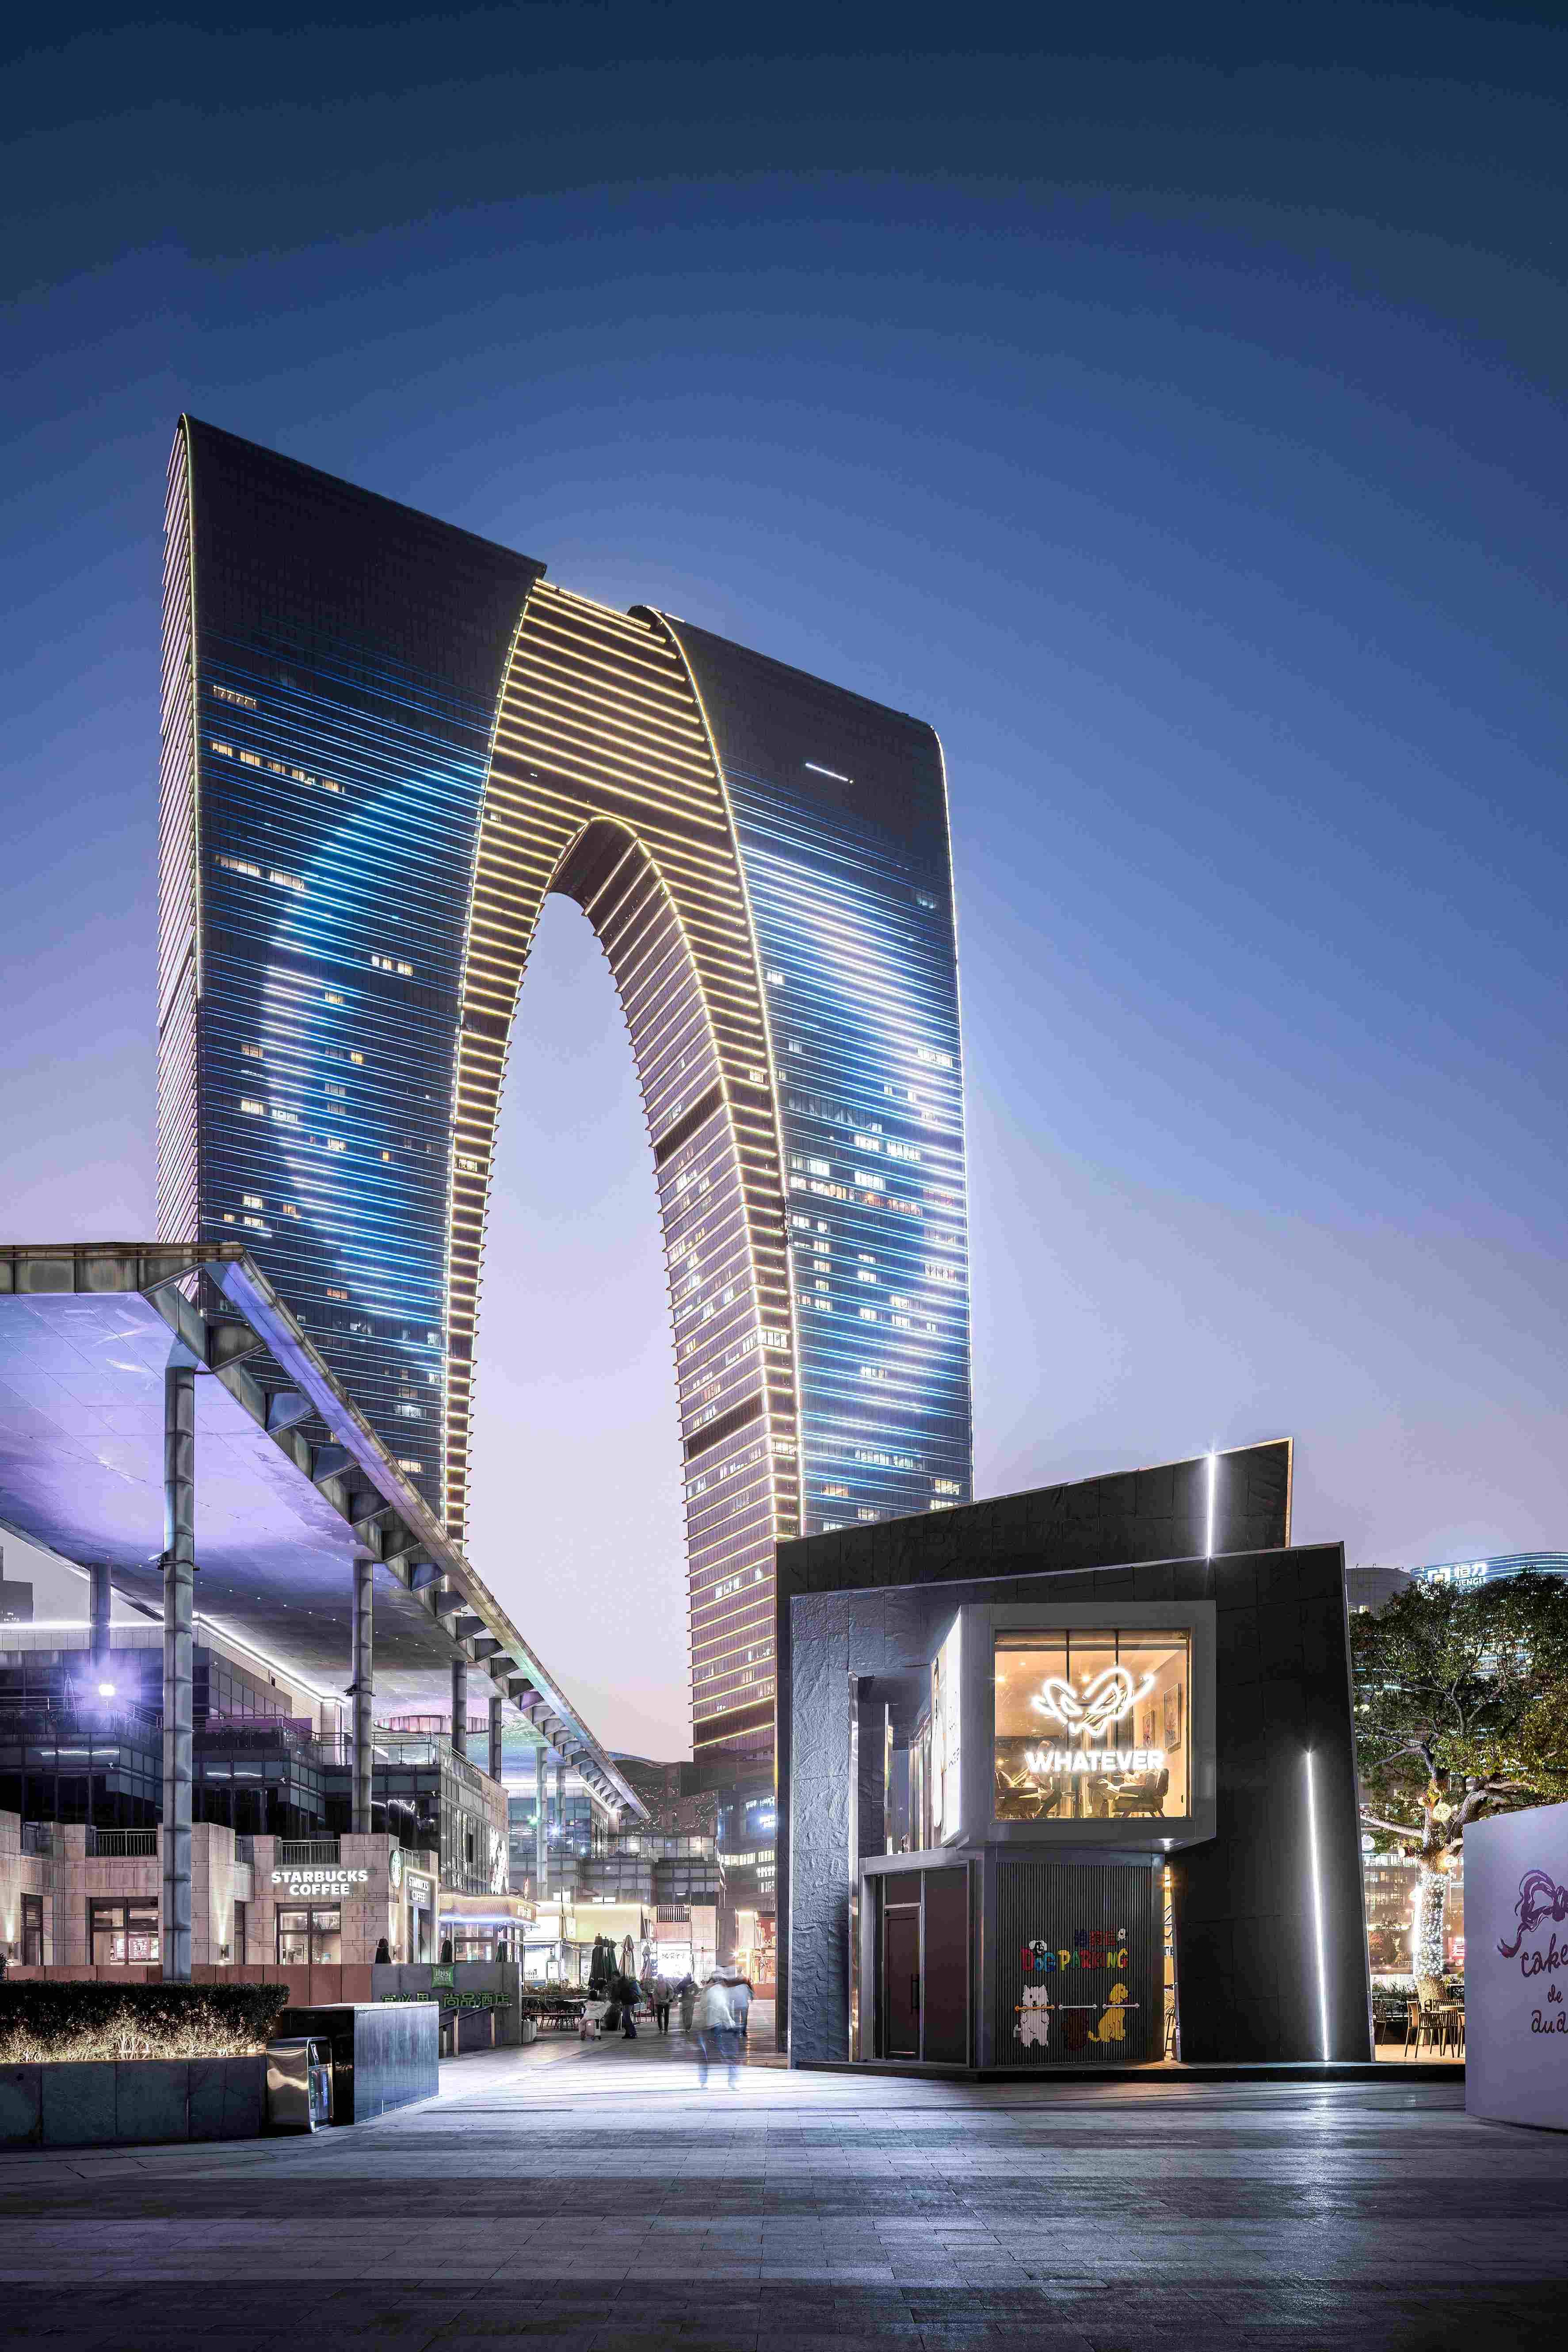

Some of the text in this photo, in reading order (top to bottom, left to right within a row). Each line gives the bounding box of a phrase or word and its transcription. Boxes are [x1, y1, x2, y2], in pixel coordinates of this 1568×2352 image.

[1026, 1750, 1164, 1772] WHATEVER
[271, 1870, 368, 1883] STARBUCKS
[289, 1884, 350, 1895] COFFEE
[1057, 1947, 1129, 1971] PARKING
[1548, 1984, 1563, 2003] de
